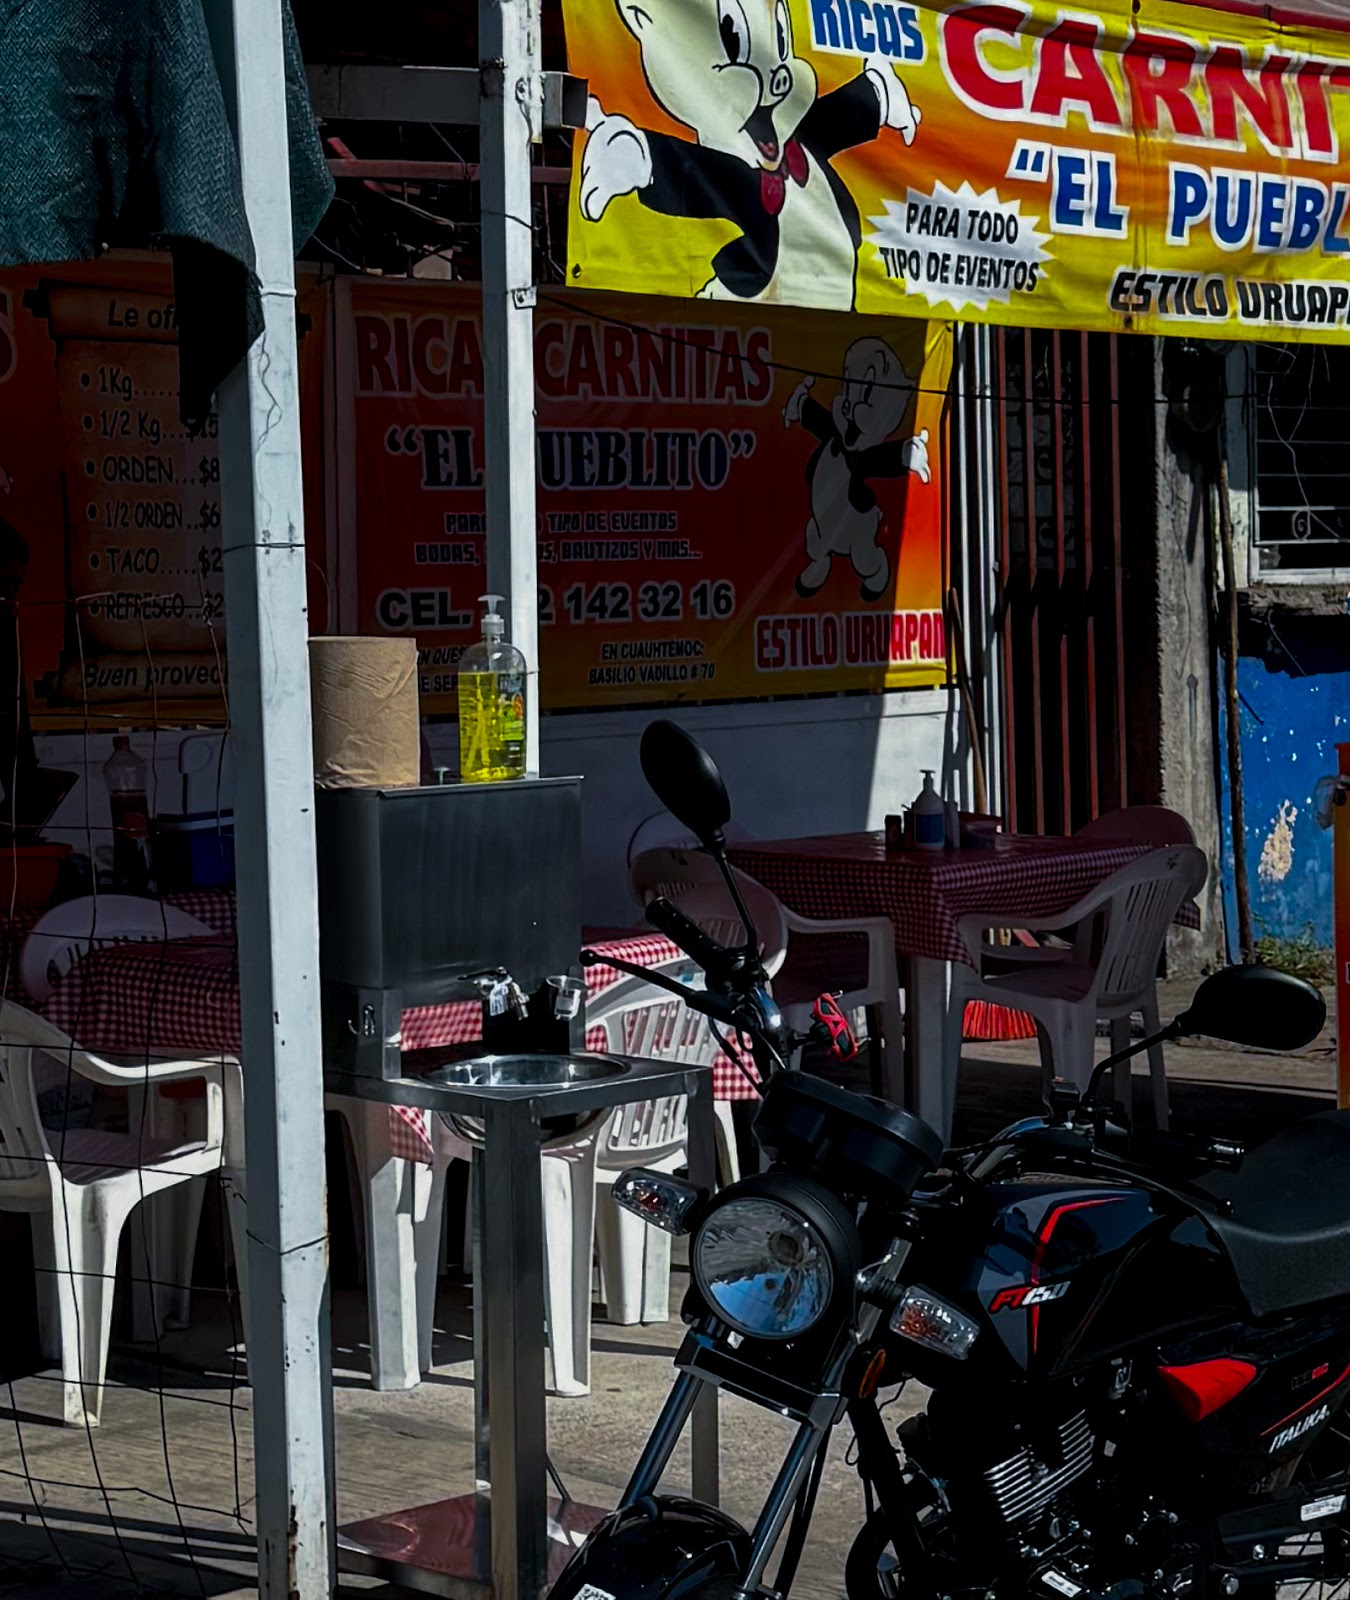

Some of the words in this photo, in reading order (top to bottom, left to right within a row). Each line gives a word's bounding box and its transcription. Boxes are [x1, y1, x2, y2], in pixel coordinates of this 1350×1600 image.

[906, 202, 960, 238] PARA
[967, 209, 1018, 244] TODO
[879, 246, 920, 281] TIPO
[927, 252, 951, 284] DE
[954, 254, 1039, 292] EVENTOS
[1110, 271, 1228, 317] ESTILO
[108, 300, 139, 328] Le
[355, 316, 484, 395] RICA
[534, 323, 769, 401] CARNITAS
[100, 410, 131, 437] 1/2
[537, 430, 755, 488] UEBLITO”
[105, 502, 129, 528] 1/2
[549, 512, 580, 532] TIPO
[586, 512, 606, 531] DE
[612, 511, 678, 531] EVENTOS
[562, 541, 638, 559] BAUTIZOS
[642, 541, 654, 557] Y
[379, 590, 472, 627] CEL.
[566, 586, 630, 620] 142
[641, 584, 681, 618] 32
[693, 582, 734, 615] 16
[757, 616, 838, 668] ESTILO
[845, 612, 945, 663] URUAPAN
[84, 664, 138, 688] Buen
[589, 666, 637, 685] BASILIO
[639, 663, 688, 682] VADILLO
[702, 662, 716, 679] 70
